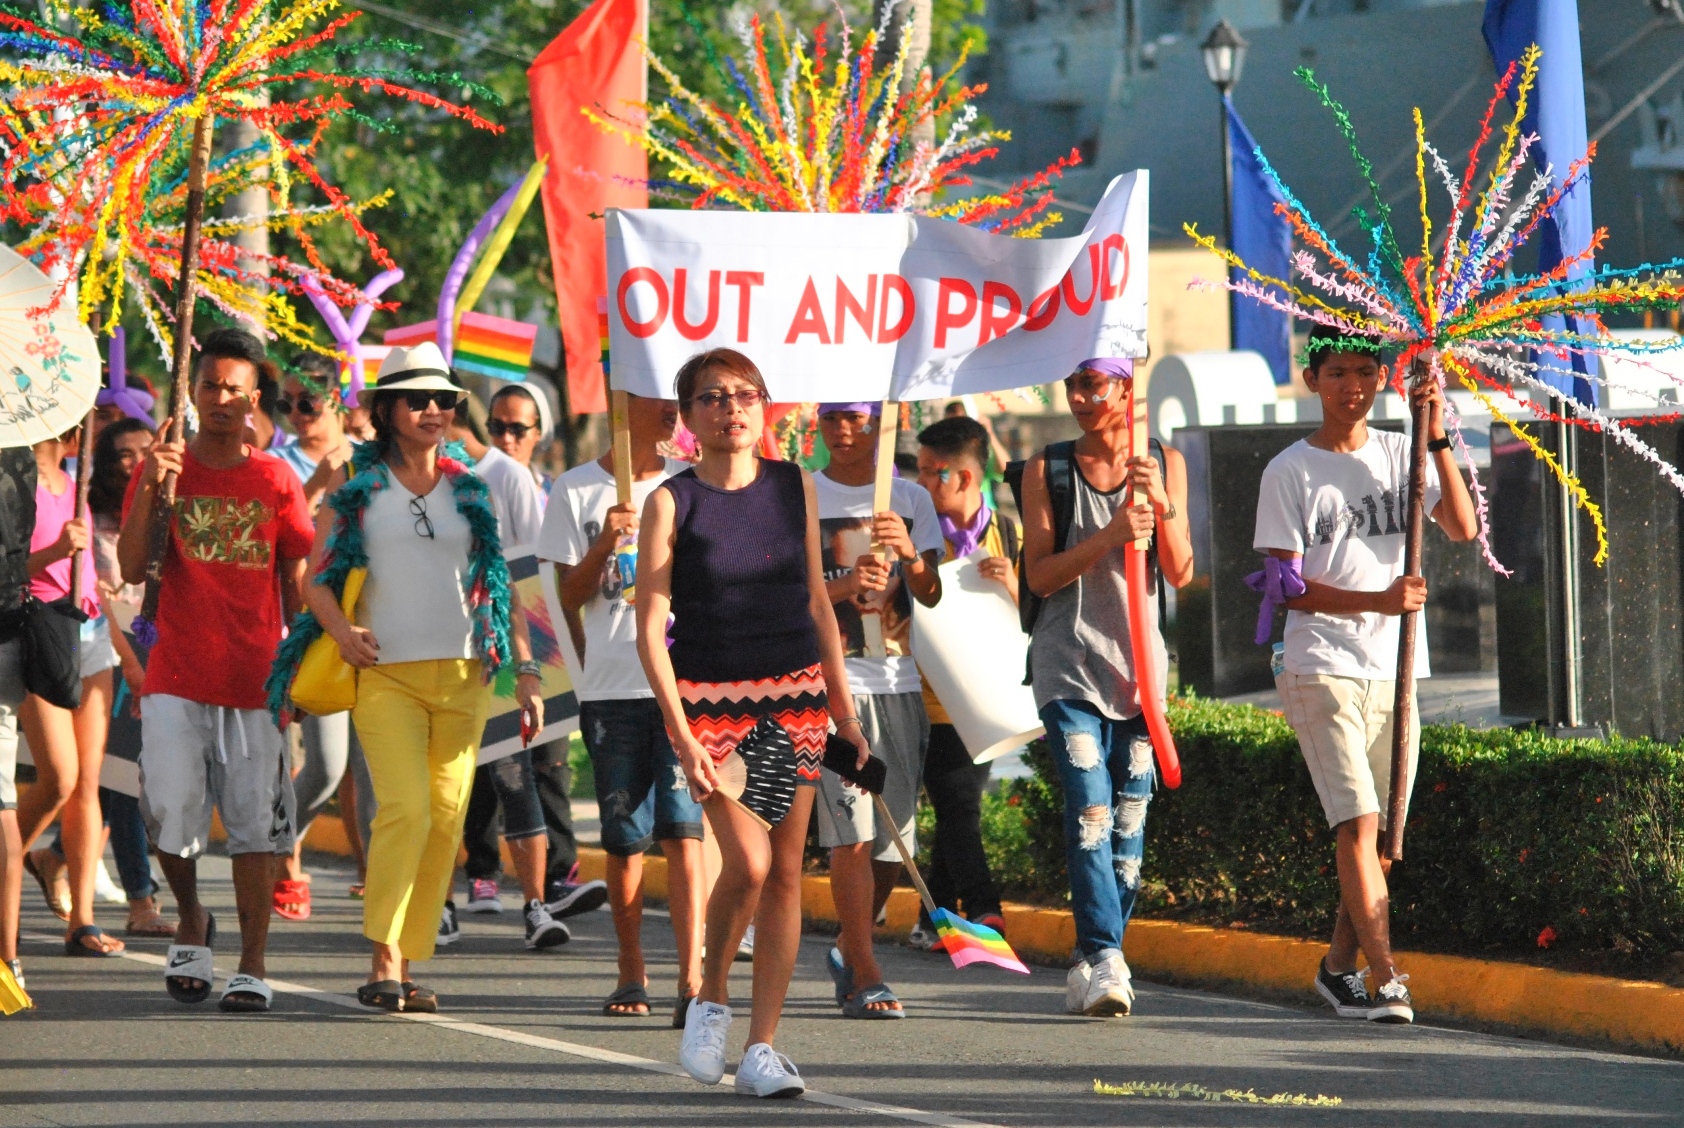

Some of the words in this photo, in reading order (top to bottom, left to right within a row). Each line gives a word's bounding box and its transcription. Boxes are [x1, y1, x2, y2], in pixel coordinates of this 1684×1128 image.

[616, 266, 765, 343] OUT
[784, 272, 916, 345] AND
[932, 232, 1131, 349] PROUD
[176, 950, 196, 960] NIKE
[234, 976, 254, 985] NIKE
